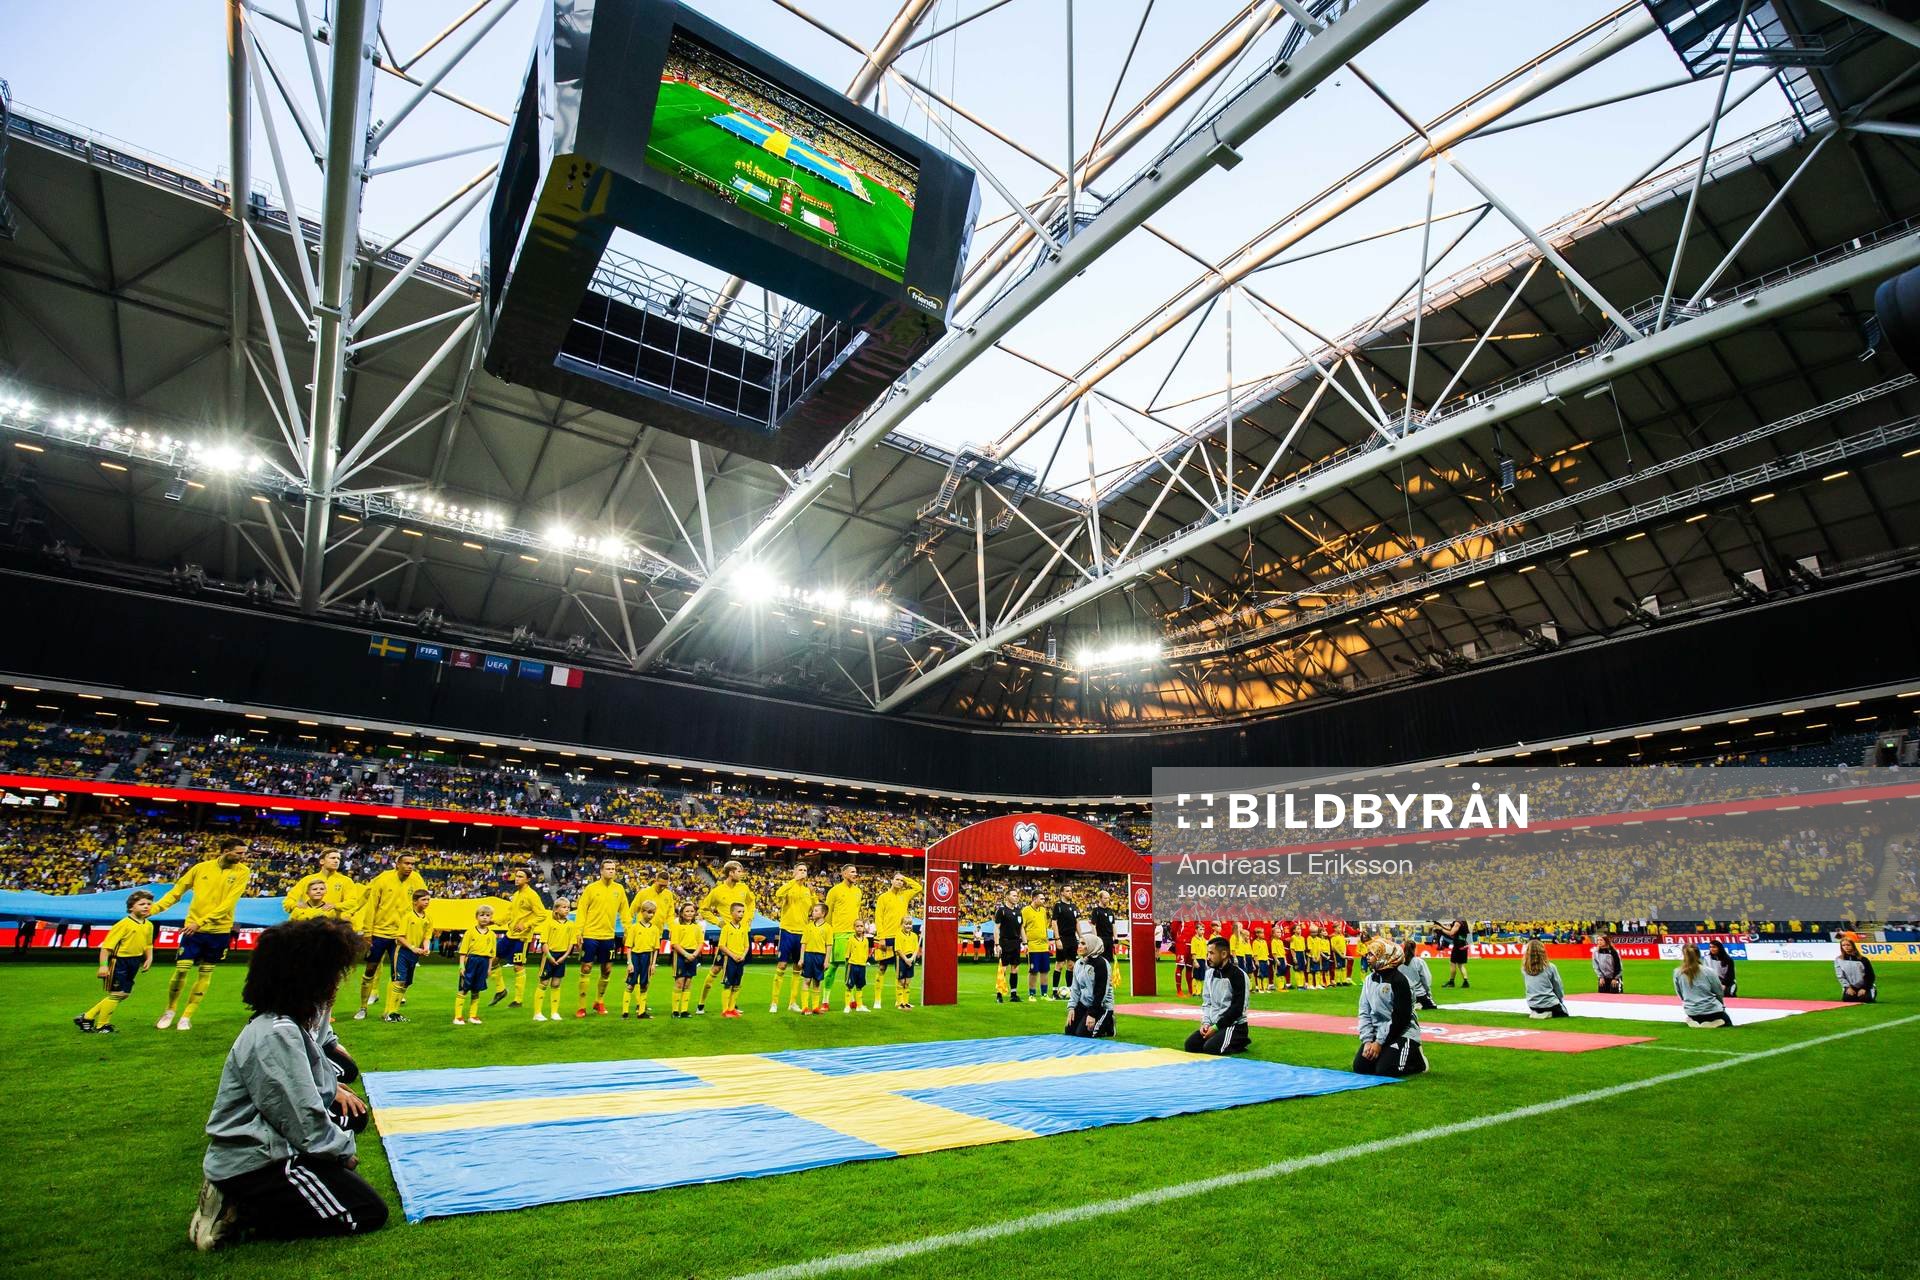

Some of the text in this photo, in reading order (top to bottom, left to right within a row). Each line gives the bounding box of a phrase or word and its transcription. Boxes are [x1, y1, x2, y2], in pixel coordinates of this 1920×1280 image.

[420, 647, 438, 656] FIFA
[487, 661, 508, 670] UEFA
[1043, 832, 1081, 843] EUROPEAN
[1039, 841, 1086, 855] QUALIFIERS
[928, 905, 956, 914] RESPECT
[1132, 912, 1152, 920] RESPECT
